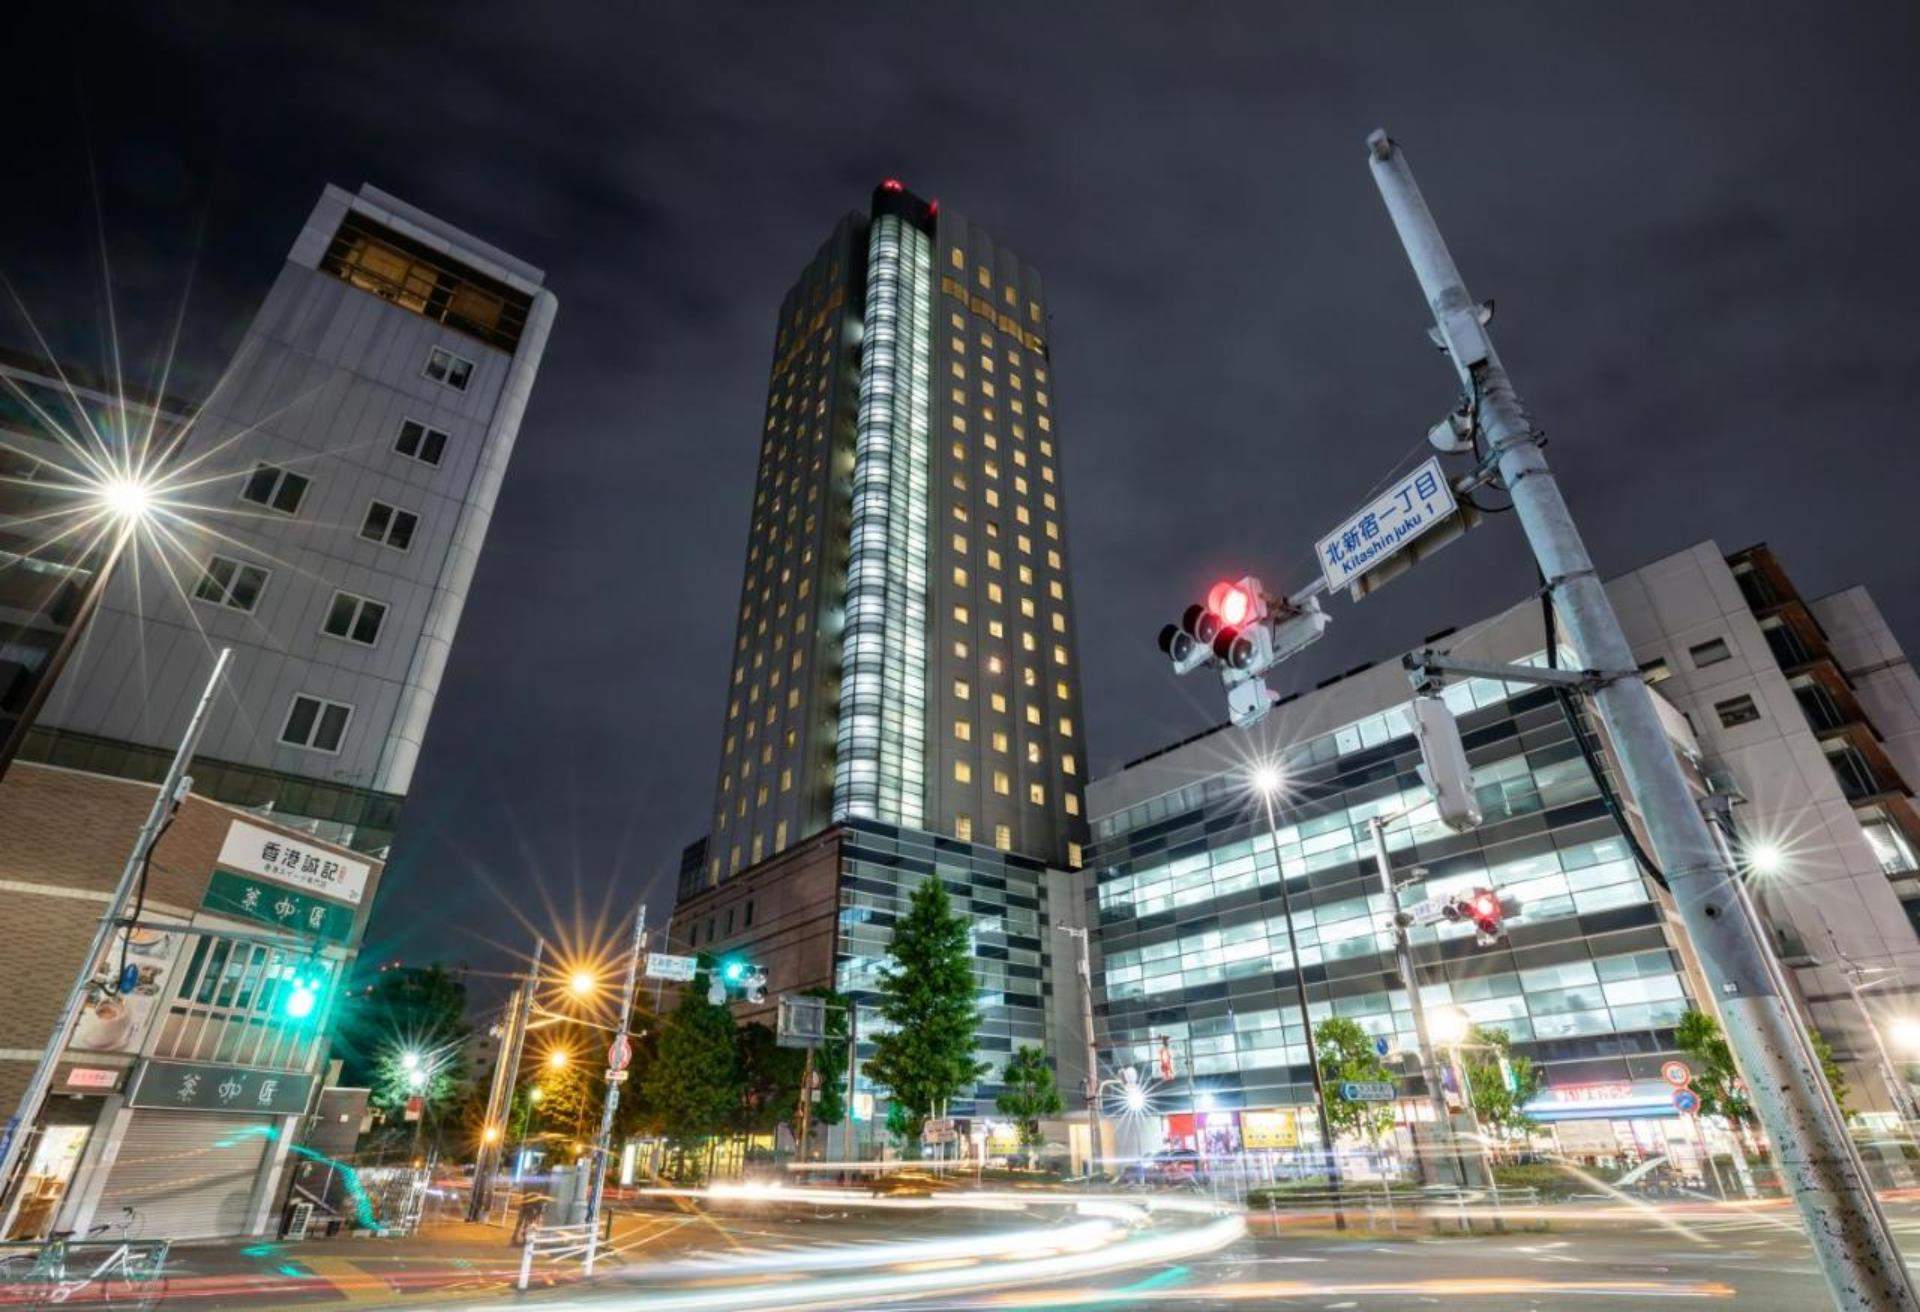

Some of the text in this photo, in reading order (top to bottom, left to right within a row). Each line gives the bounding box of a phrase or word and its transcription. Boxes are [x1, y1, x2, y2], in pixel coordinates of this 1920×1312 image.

[1326, 471, 1438, 566] 北新宿一丁目
[1342, 502, 1435, 574] Kitashinjuku 1
[261, 841, 339, 882] 香港誠記
